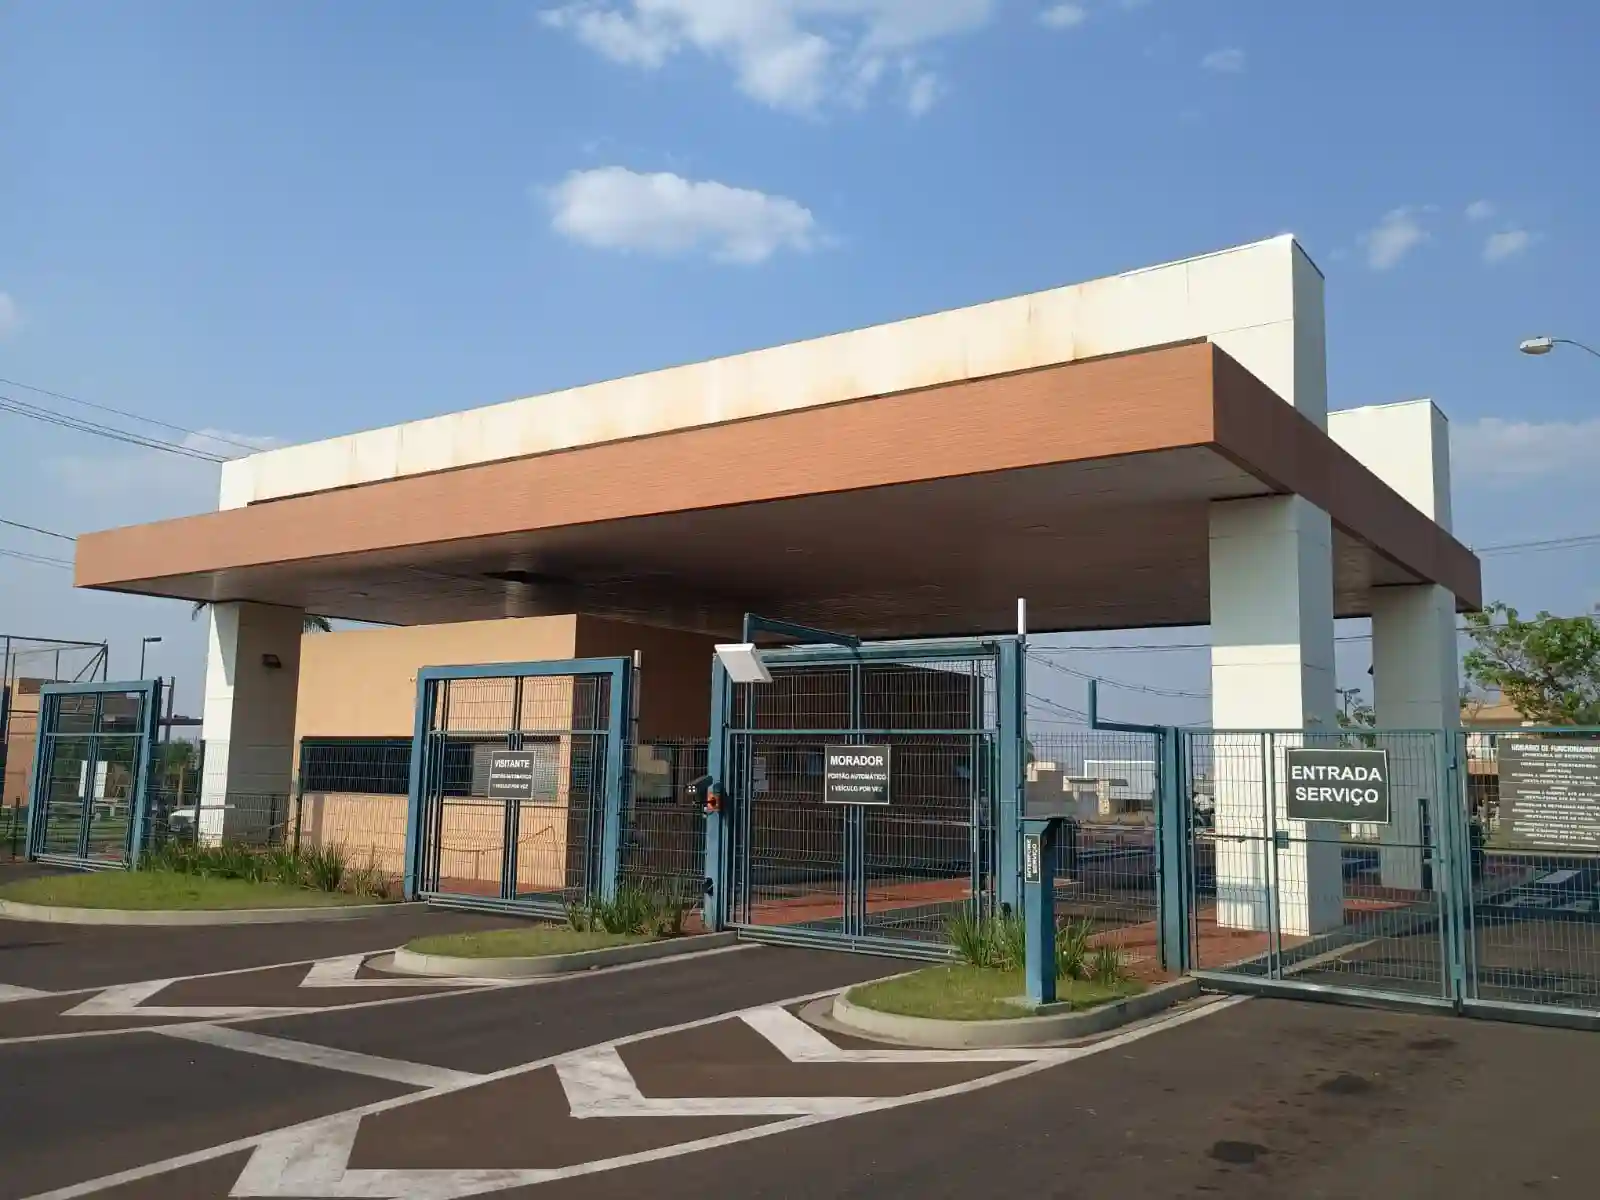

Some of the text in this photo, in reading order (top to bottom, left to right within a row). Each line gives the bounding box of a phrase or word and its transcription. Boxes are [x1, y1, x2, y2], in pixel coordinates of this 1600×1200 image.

[494, 759, 531, 768] VISITANTE
[830, 755, 884, 767] MORADOR
[1291, 765, 1382, 781] ENTRADA
[859, 785, 871, 793] POR
[1295, 786, 1379, 806] SERVIÇO
